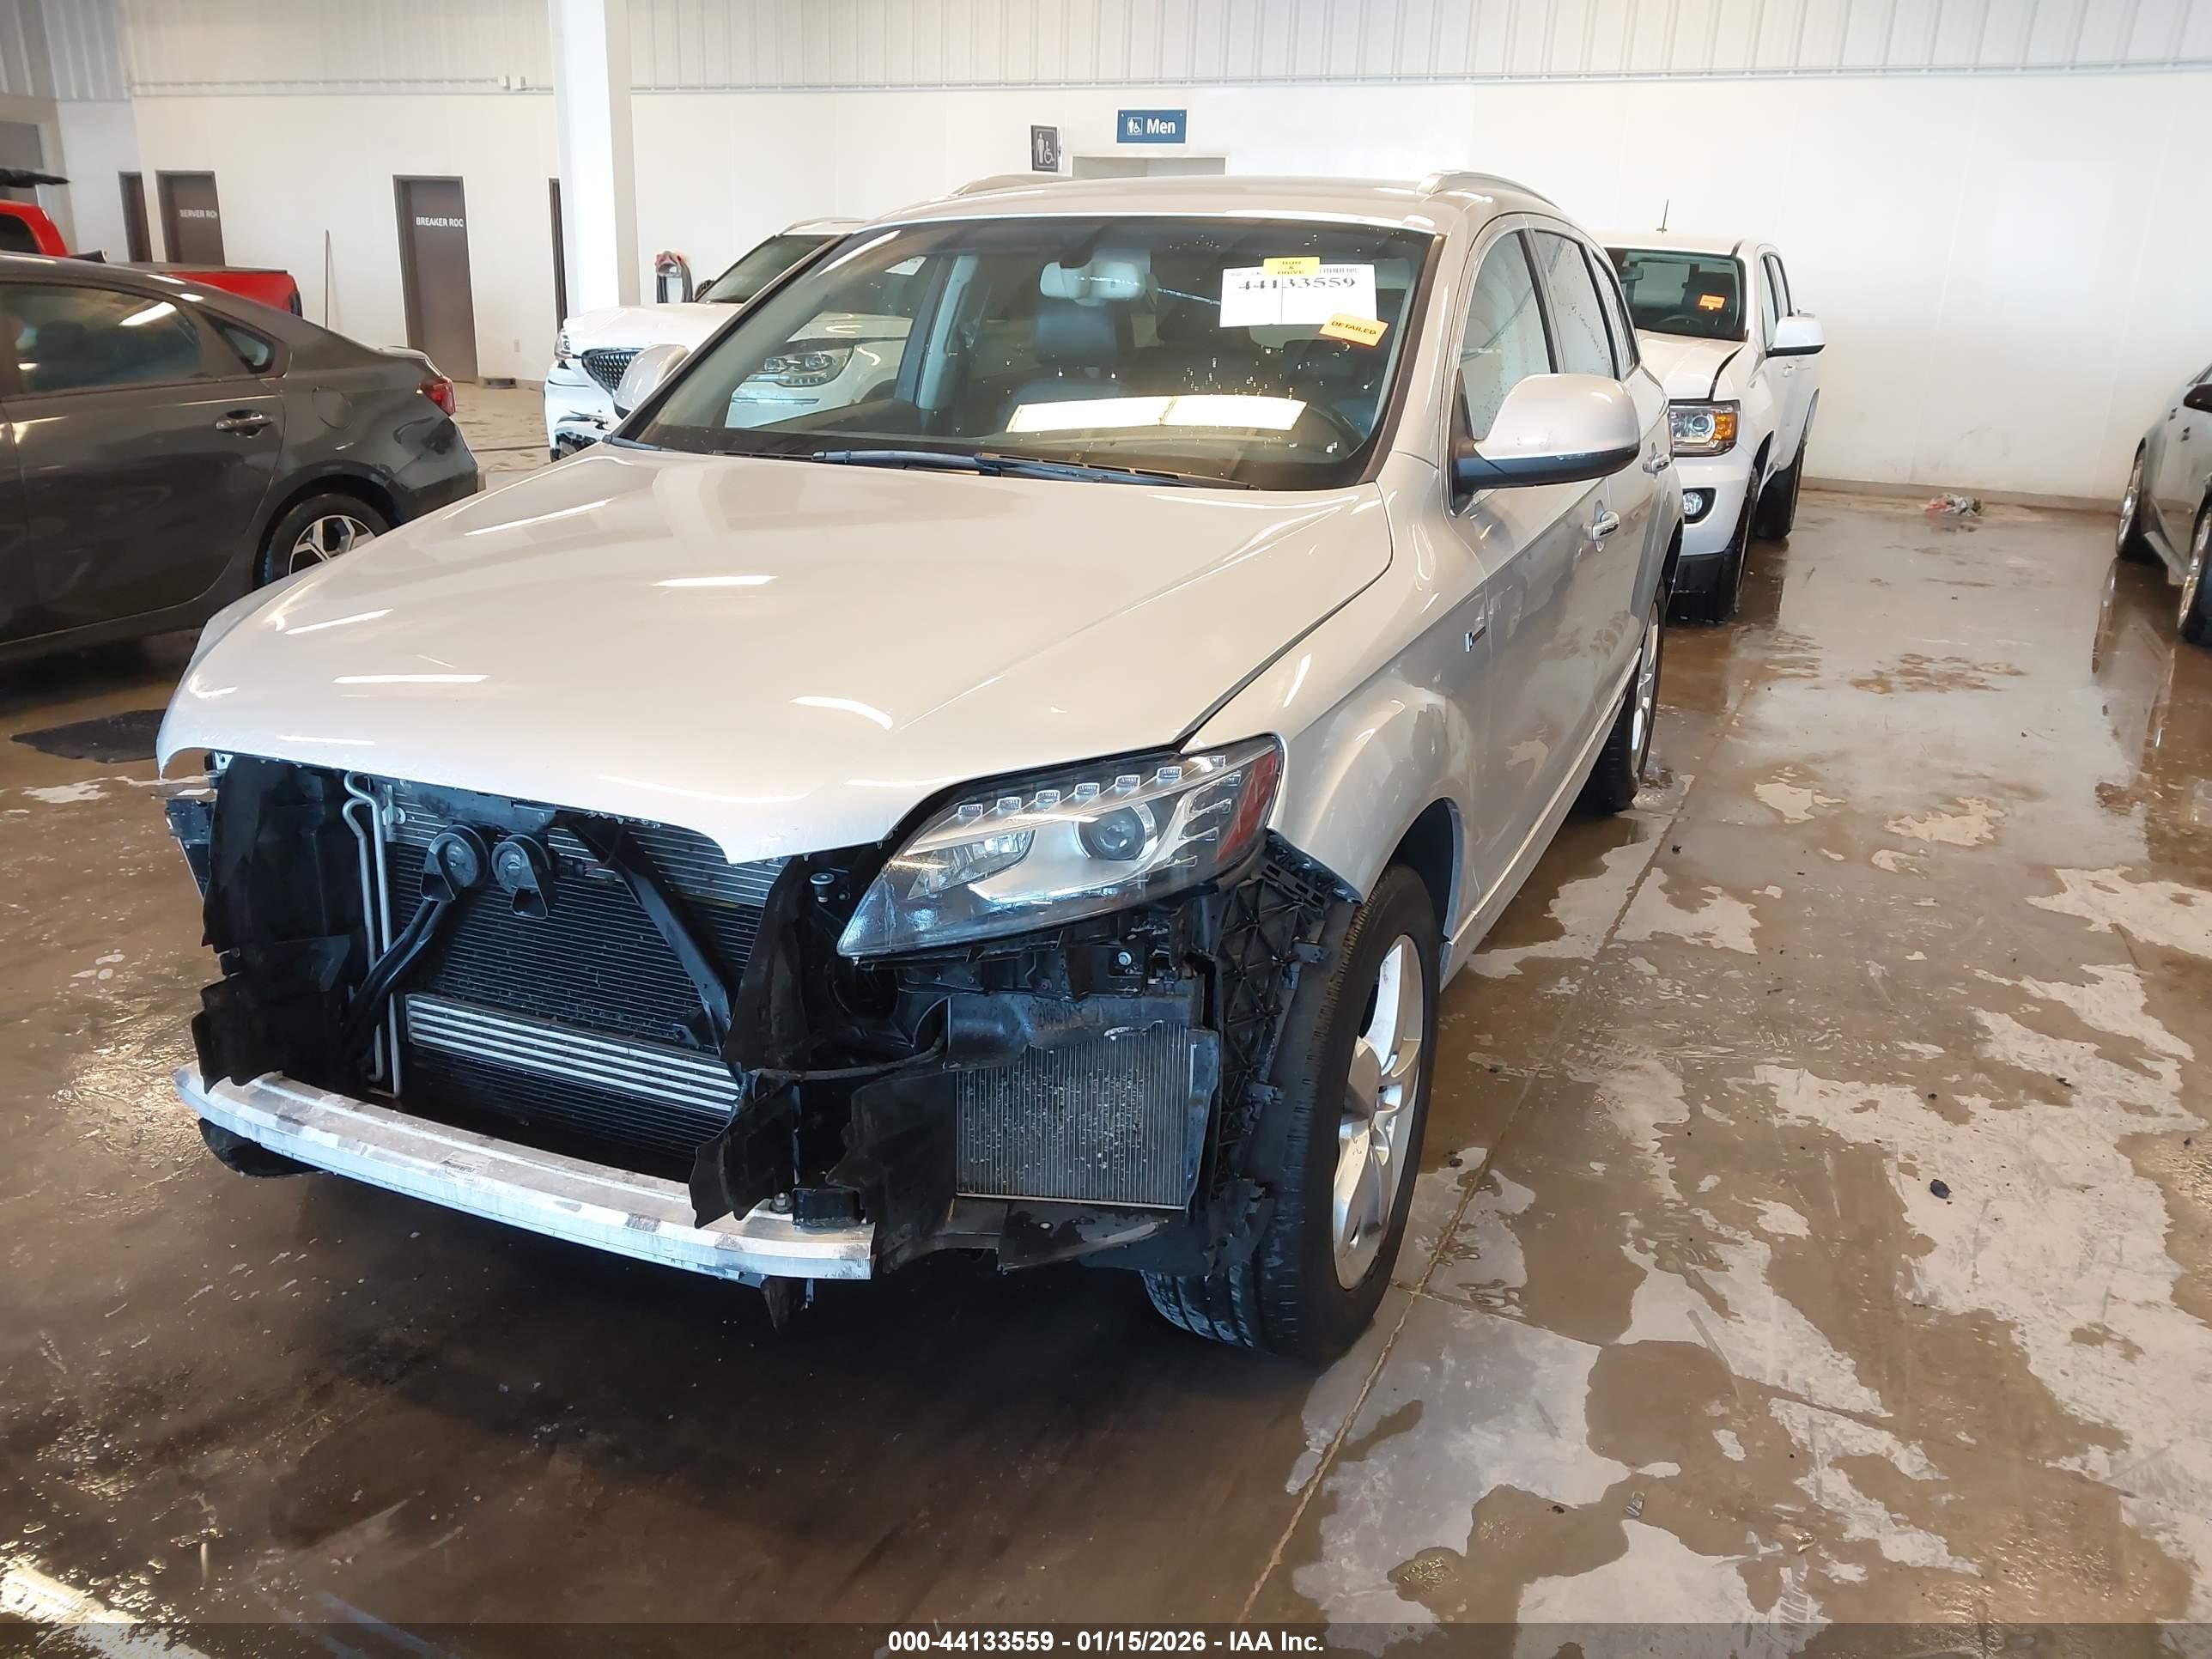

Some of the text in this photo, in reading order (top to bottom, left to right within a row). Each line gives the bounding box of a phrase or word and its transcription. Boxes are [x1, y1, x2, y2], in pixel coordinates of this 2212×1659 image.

[1146, 118, 1176, 135] Men
[416, 216, 448, 228] BREAKER
[1237, 276, 1356, 290] 44133559
[1331, 320, 1377, 336] DETAILED
